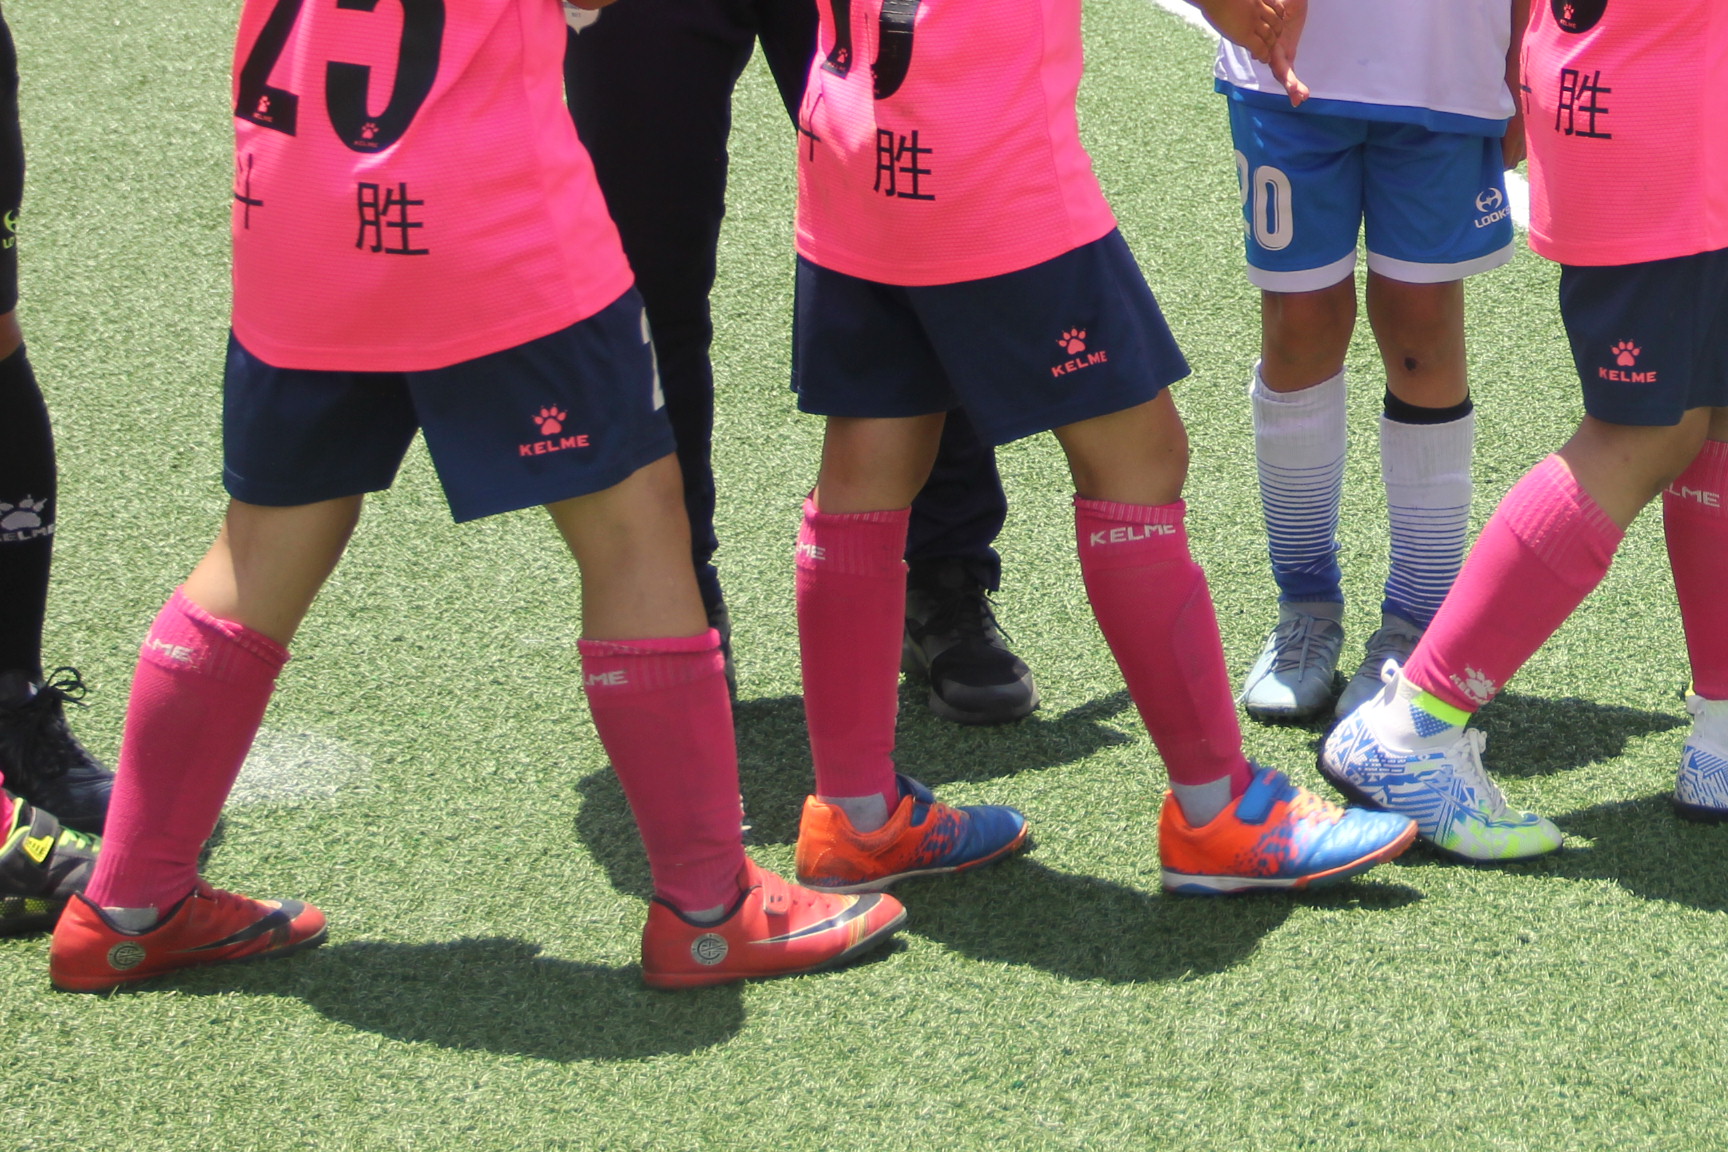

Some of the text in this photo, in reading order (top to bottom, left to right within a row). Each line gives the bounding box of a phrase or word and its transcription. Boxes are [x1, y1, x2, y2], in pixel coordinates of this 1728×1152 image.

[1051, 350, 1108, 378] KELME
[1598, 366, 1658, 384] KELME
[519, 434, 590, 458] KELME
[1090, 522, 1177, 548] KELME
